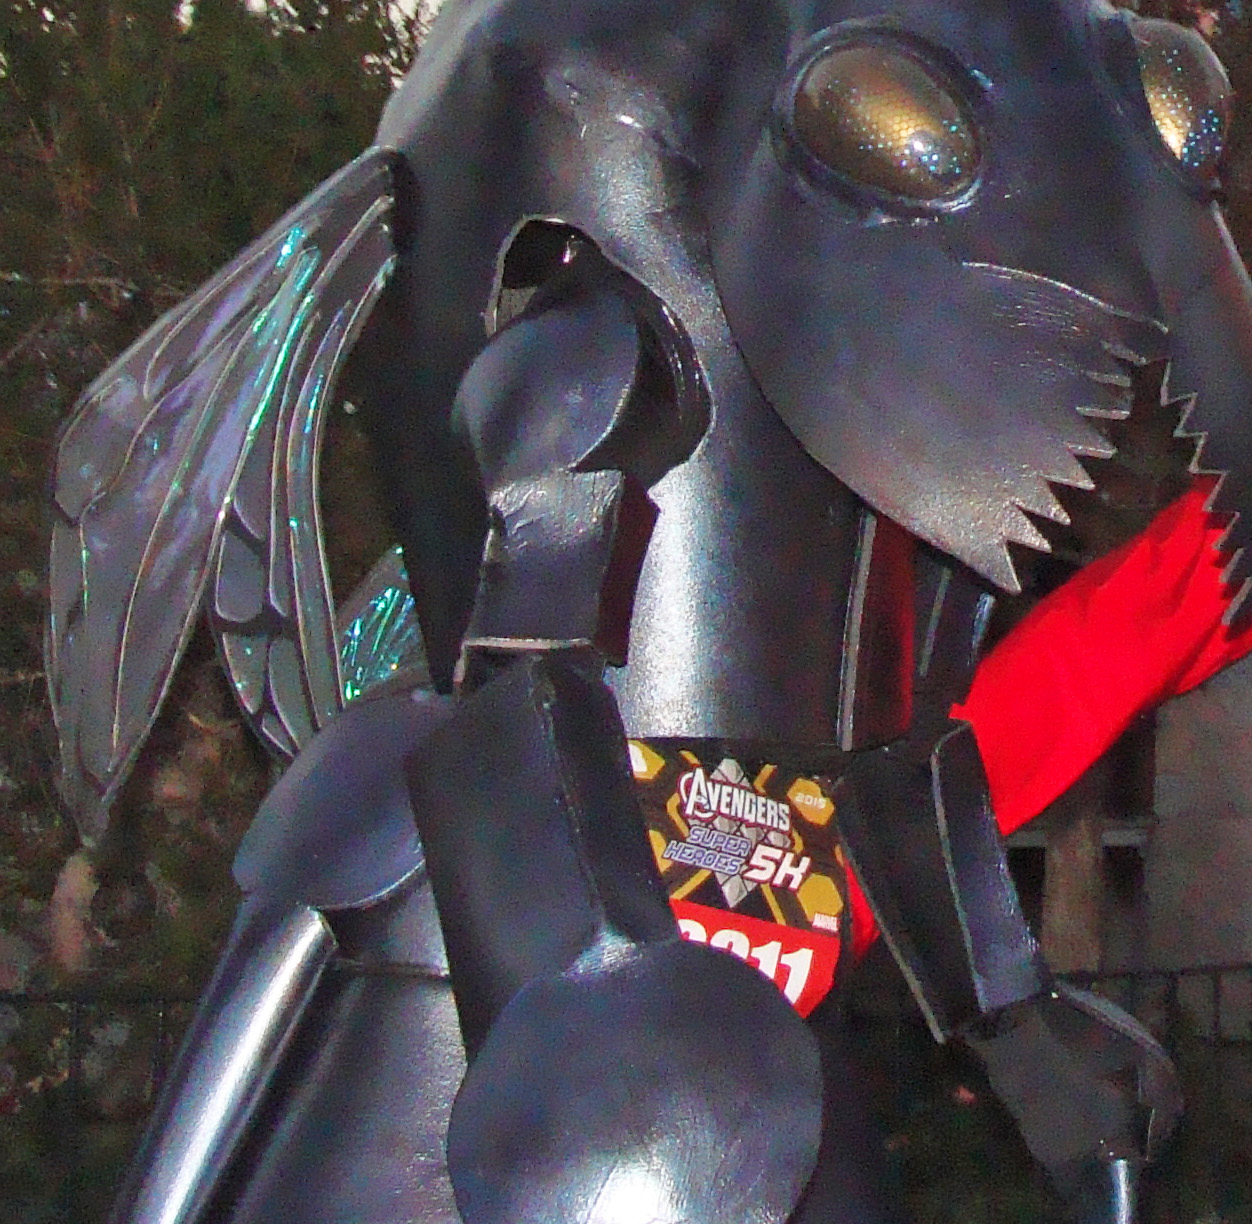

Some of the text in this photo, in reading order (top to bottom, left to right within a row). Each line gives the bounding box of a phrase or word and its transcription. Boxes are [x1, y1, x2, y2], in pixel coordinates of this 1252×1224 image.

[680, 767, 790, 831] AVENGERS
[795, 792, 827, 809] 2015
[663, 841, 745, 874] HEROES
[689, 826, 750, 856] SUPER
[744, 845, 812, 890] 5K
